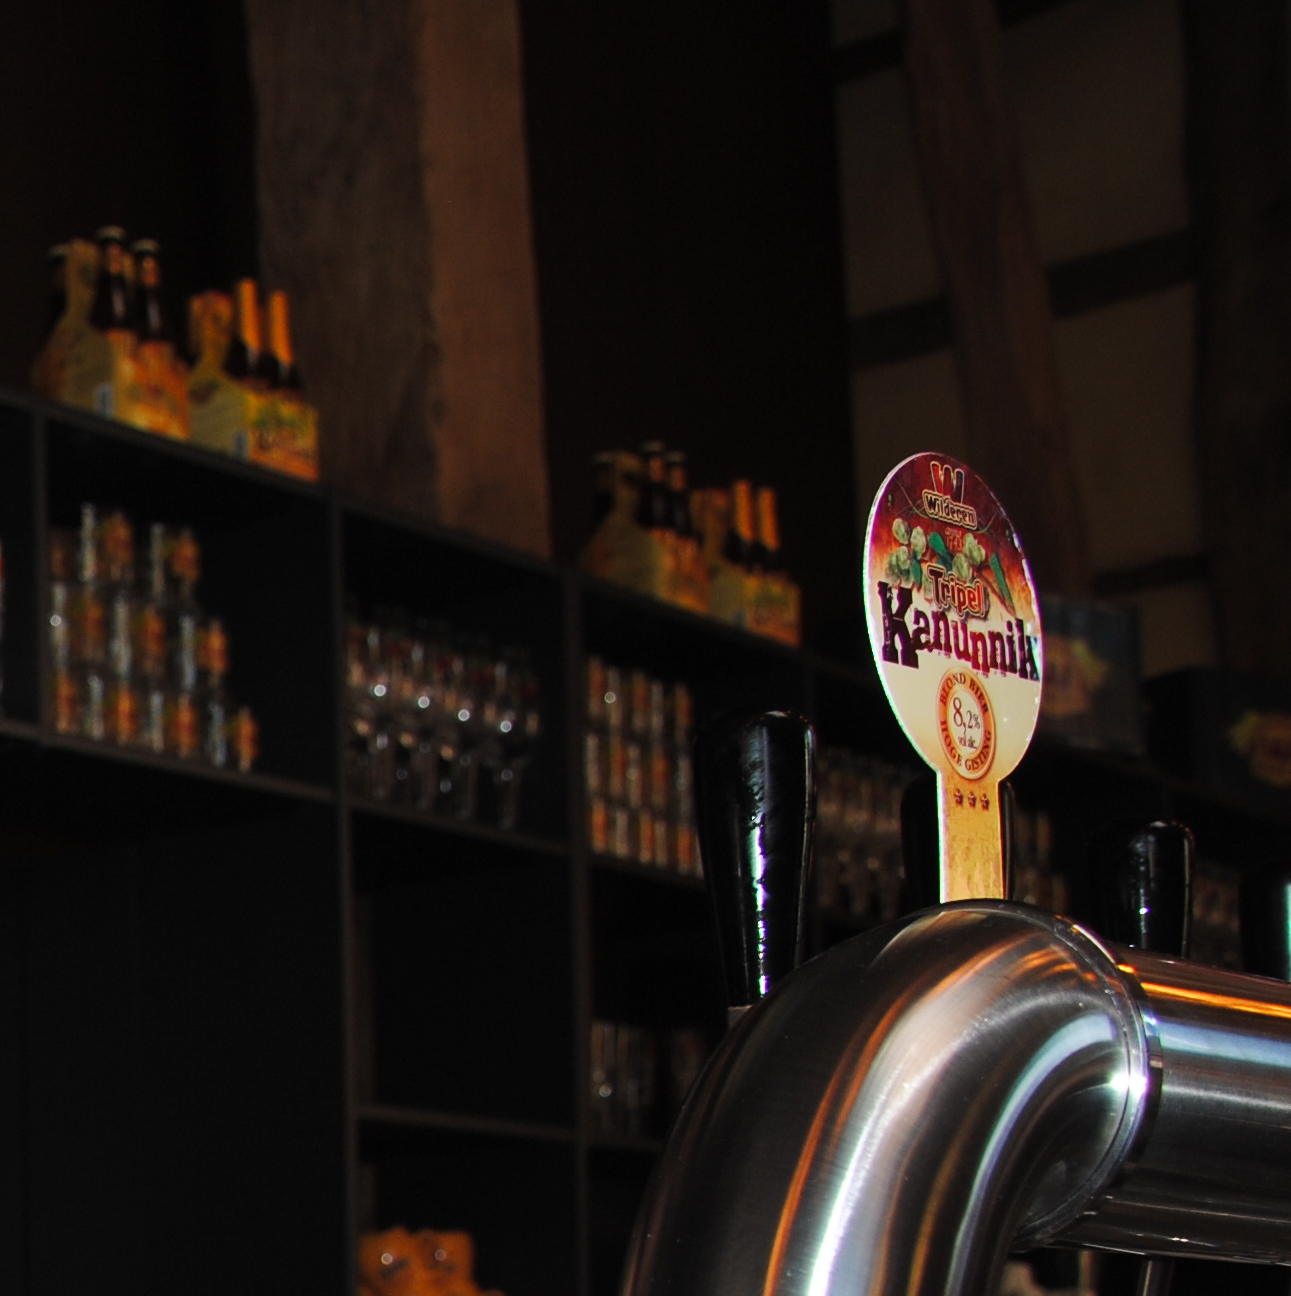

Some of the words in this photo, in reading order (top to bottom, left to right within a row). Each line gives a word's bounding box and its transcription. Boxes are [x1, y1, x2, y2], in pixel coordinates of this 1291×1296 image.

[923, 494, 976, 526] Wilderen
[927, 565, 986, 616] Tripel
[878, 580, 1041, 682] Kanunnik
